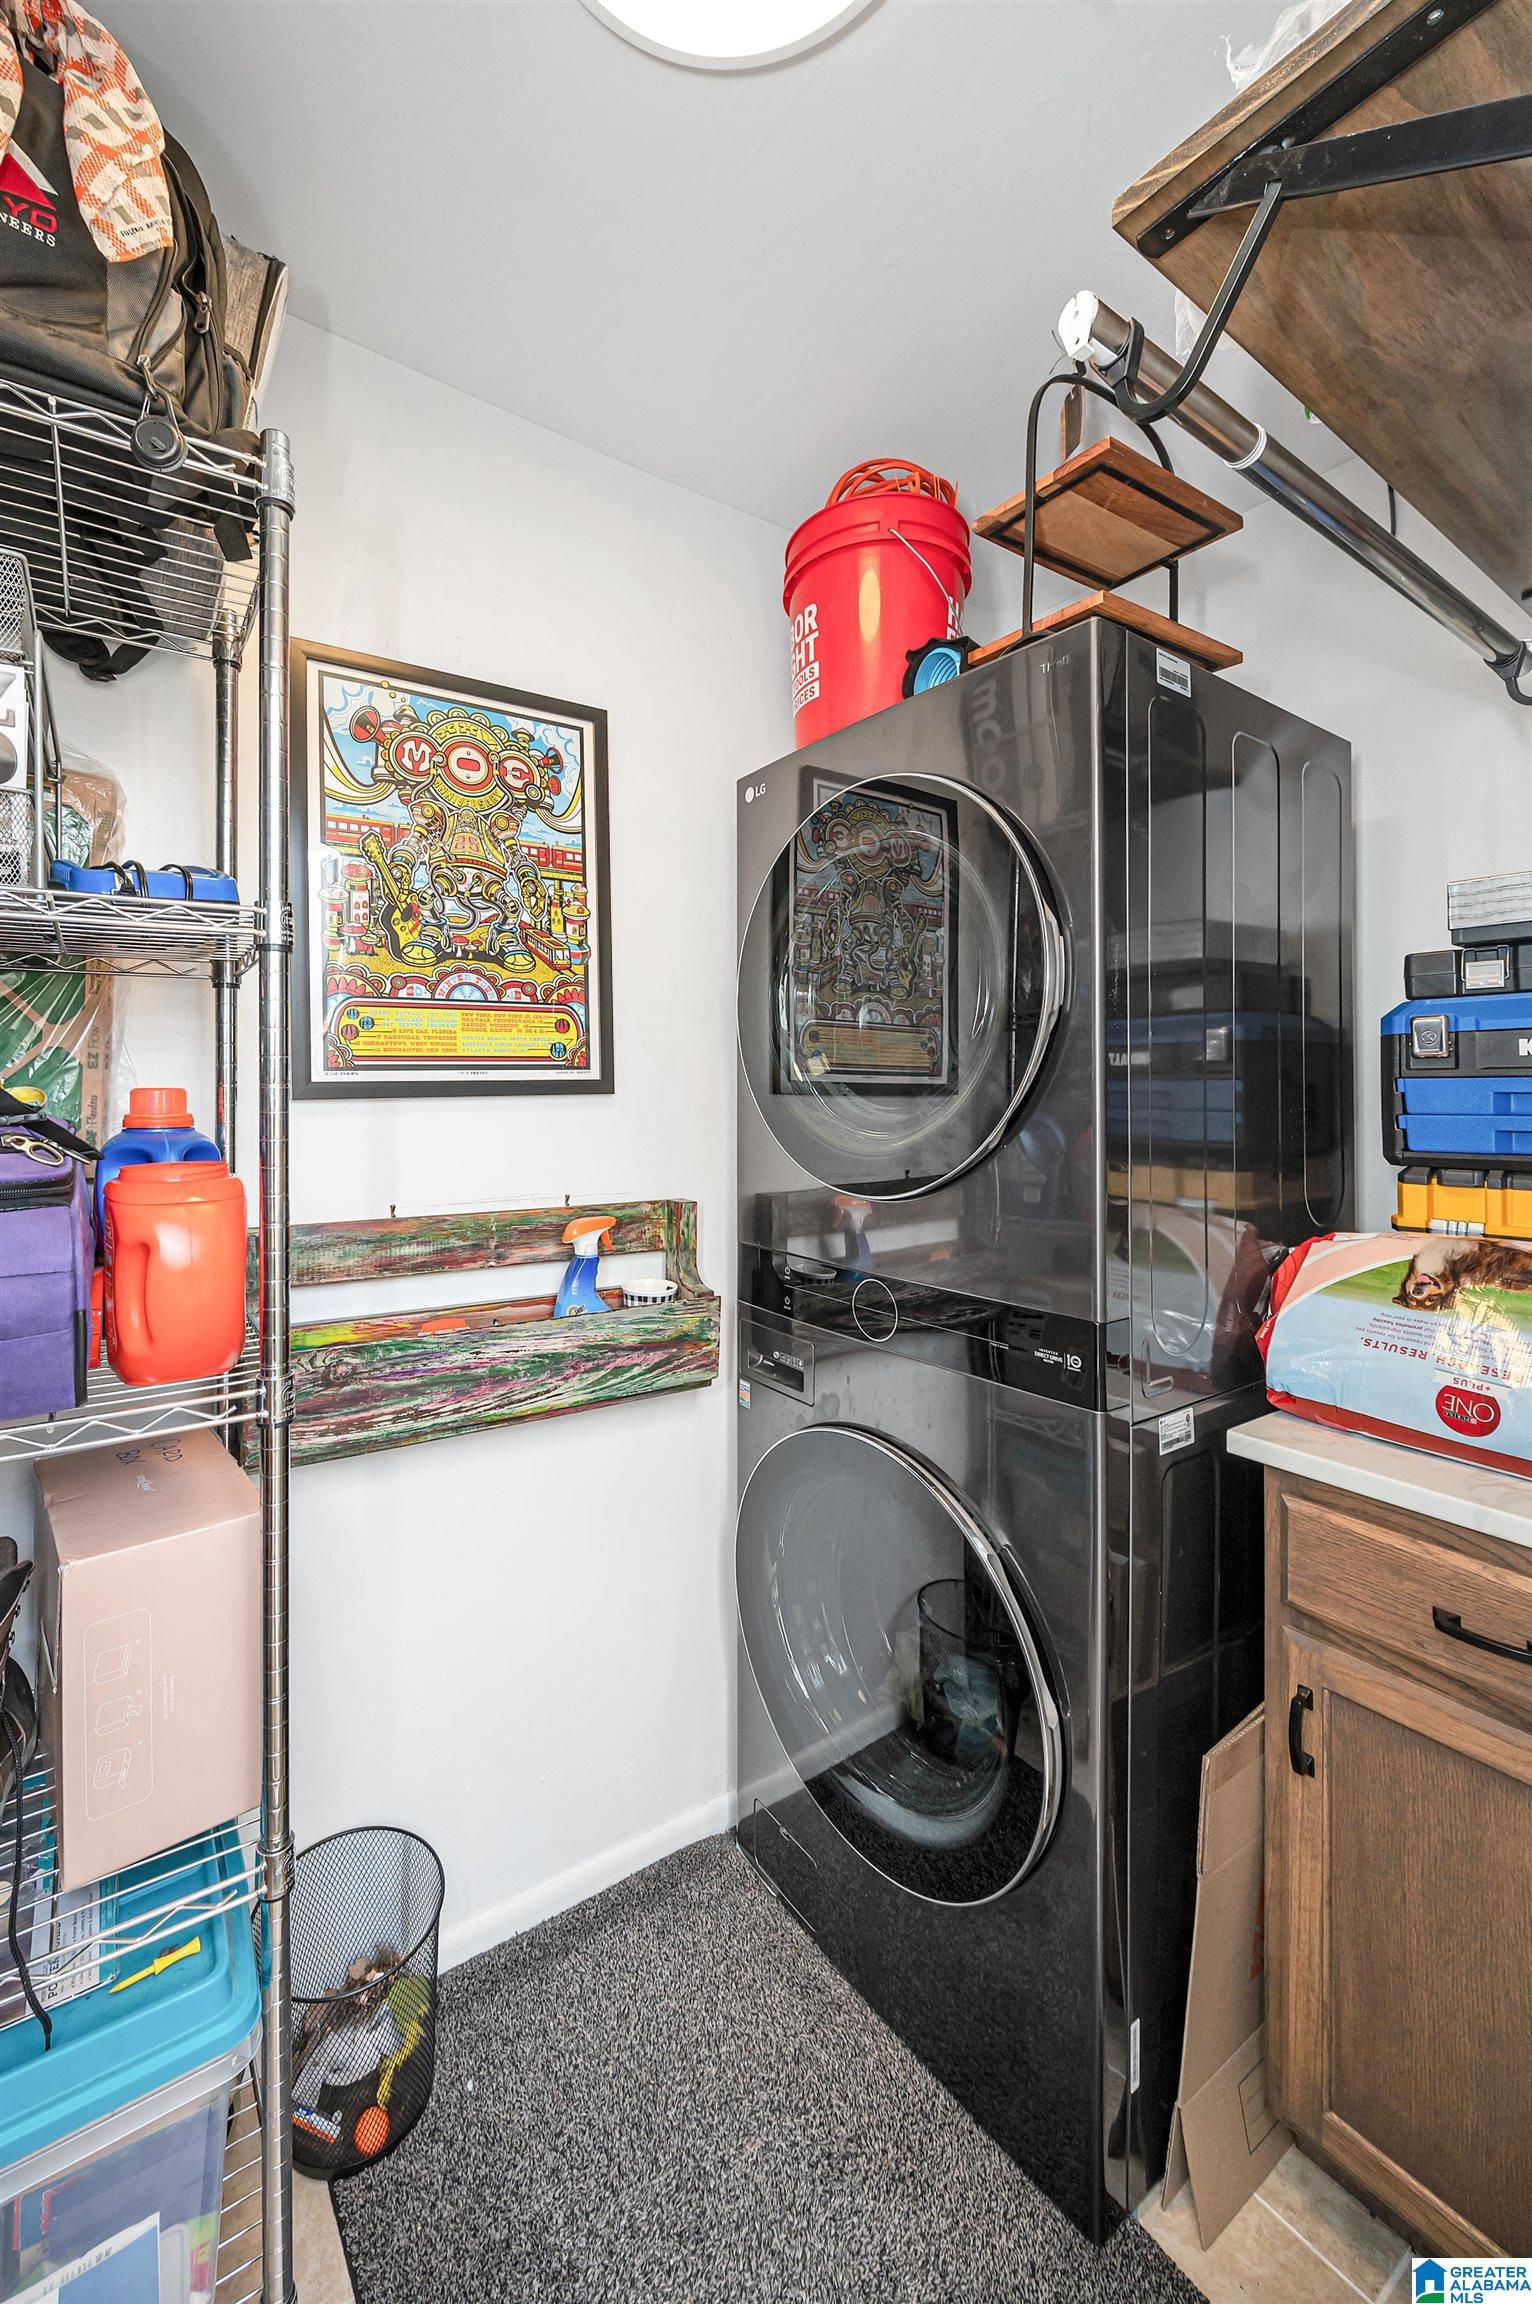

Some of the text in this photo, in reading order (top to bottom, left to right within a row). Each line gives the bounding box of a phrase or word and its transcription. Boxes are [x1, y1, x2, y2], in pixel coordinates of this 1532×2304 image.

[755, 783, 766, 797] LG
[1361, 1337, 1428, 1360] RESULTS.
[1441, 1393, 1495, 1423] ONE
